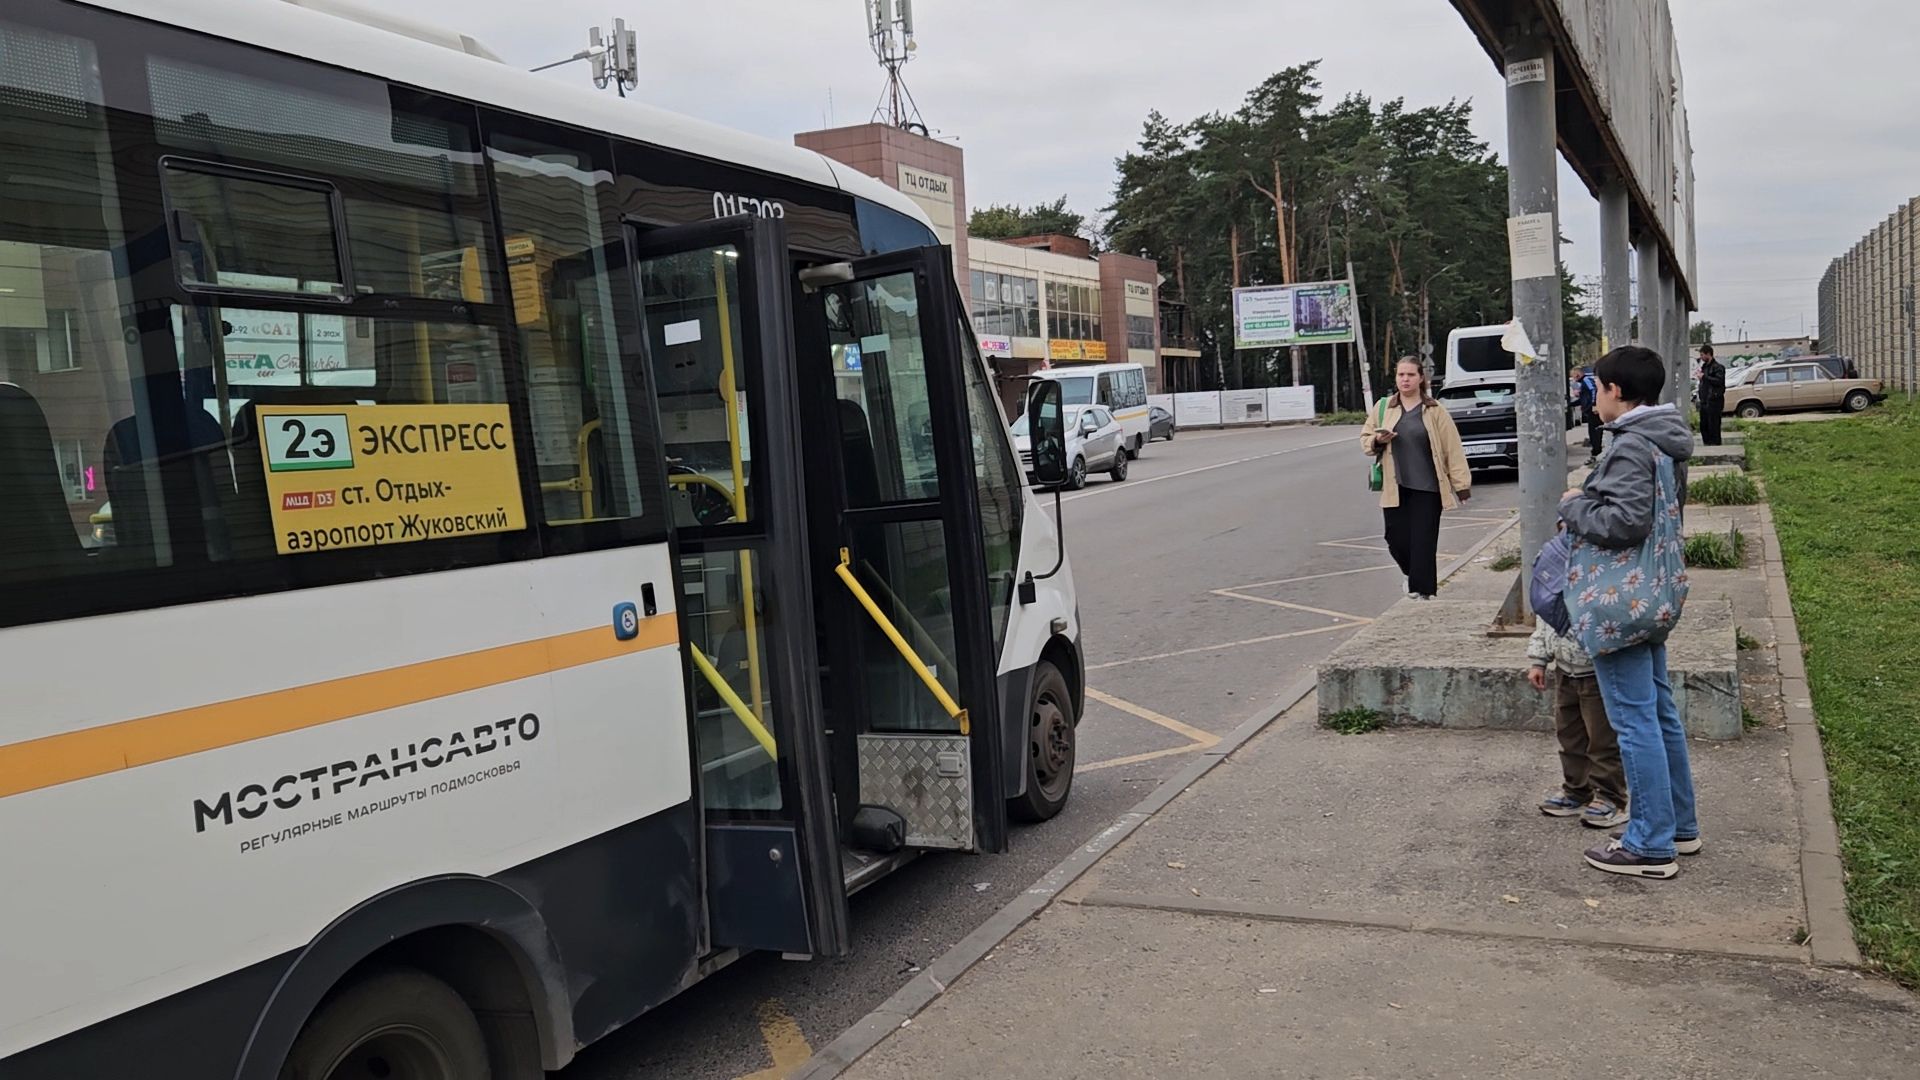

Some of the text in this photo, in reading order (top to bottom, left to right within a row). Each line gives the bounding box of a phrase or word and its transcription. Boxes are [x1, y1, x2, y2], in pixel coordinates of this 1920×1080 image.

[905, 172, 948, 194] ТЦ ОТДЫХ
[281, 418, 507, 459] 2э ЭКСПРЕСС
[286, 477, 452, 507] МЦД D3 ст. Отдых-
[287, 507, 508, 553] аэропорт Жуковский
[193, 713, 540, 833] МОСТРАНСАВТО
[240, 760, 521, 853] РЕГУЛЯРНЫЕ МАРШРУТЫ ПОДМОСКОВЬЯ
